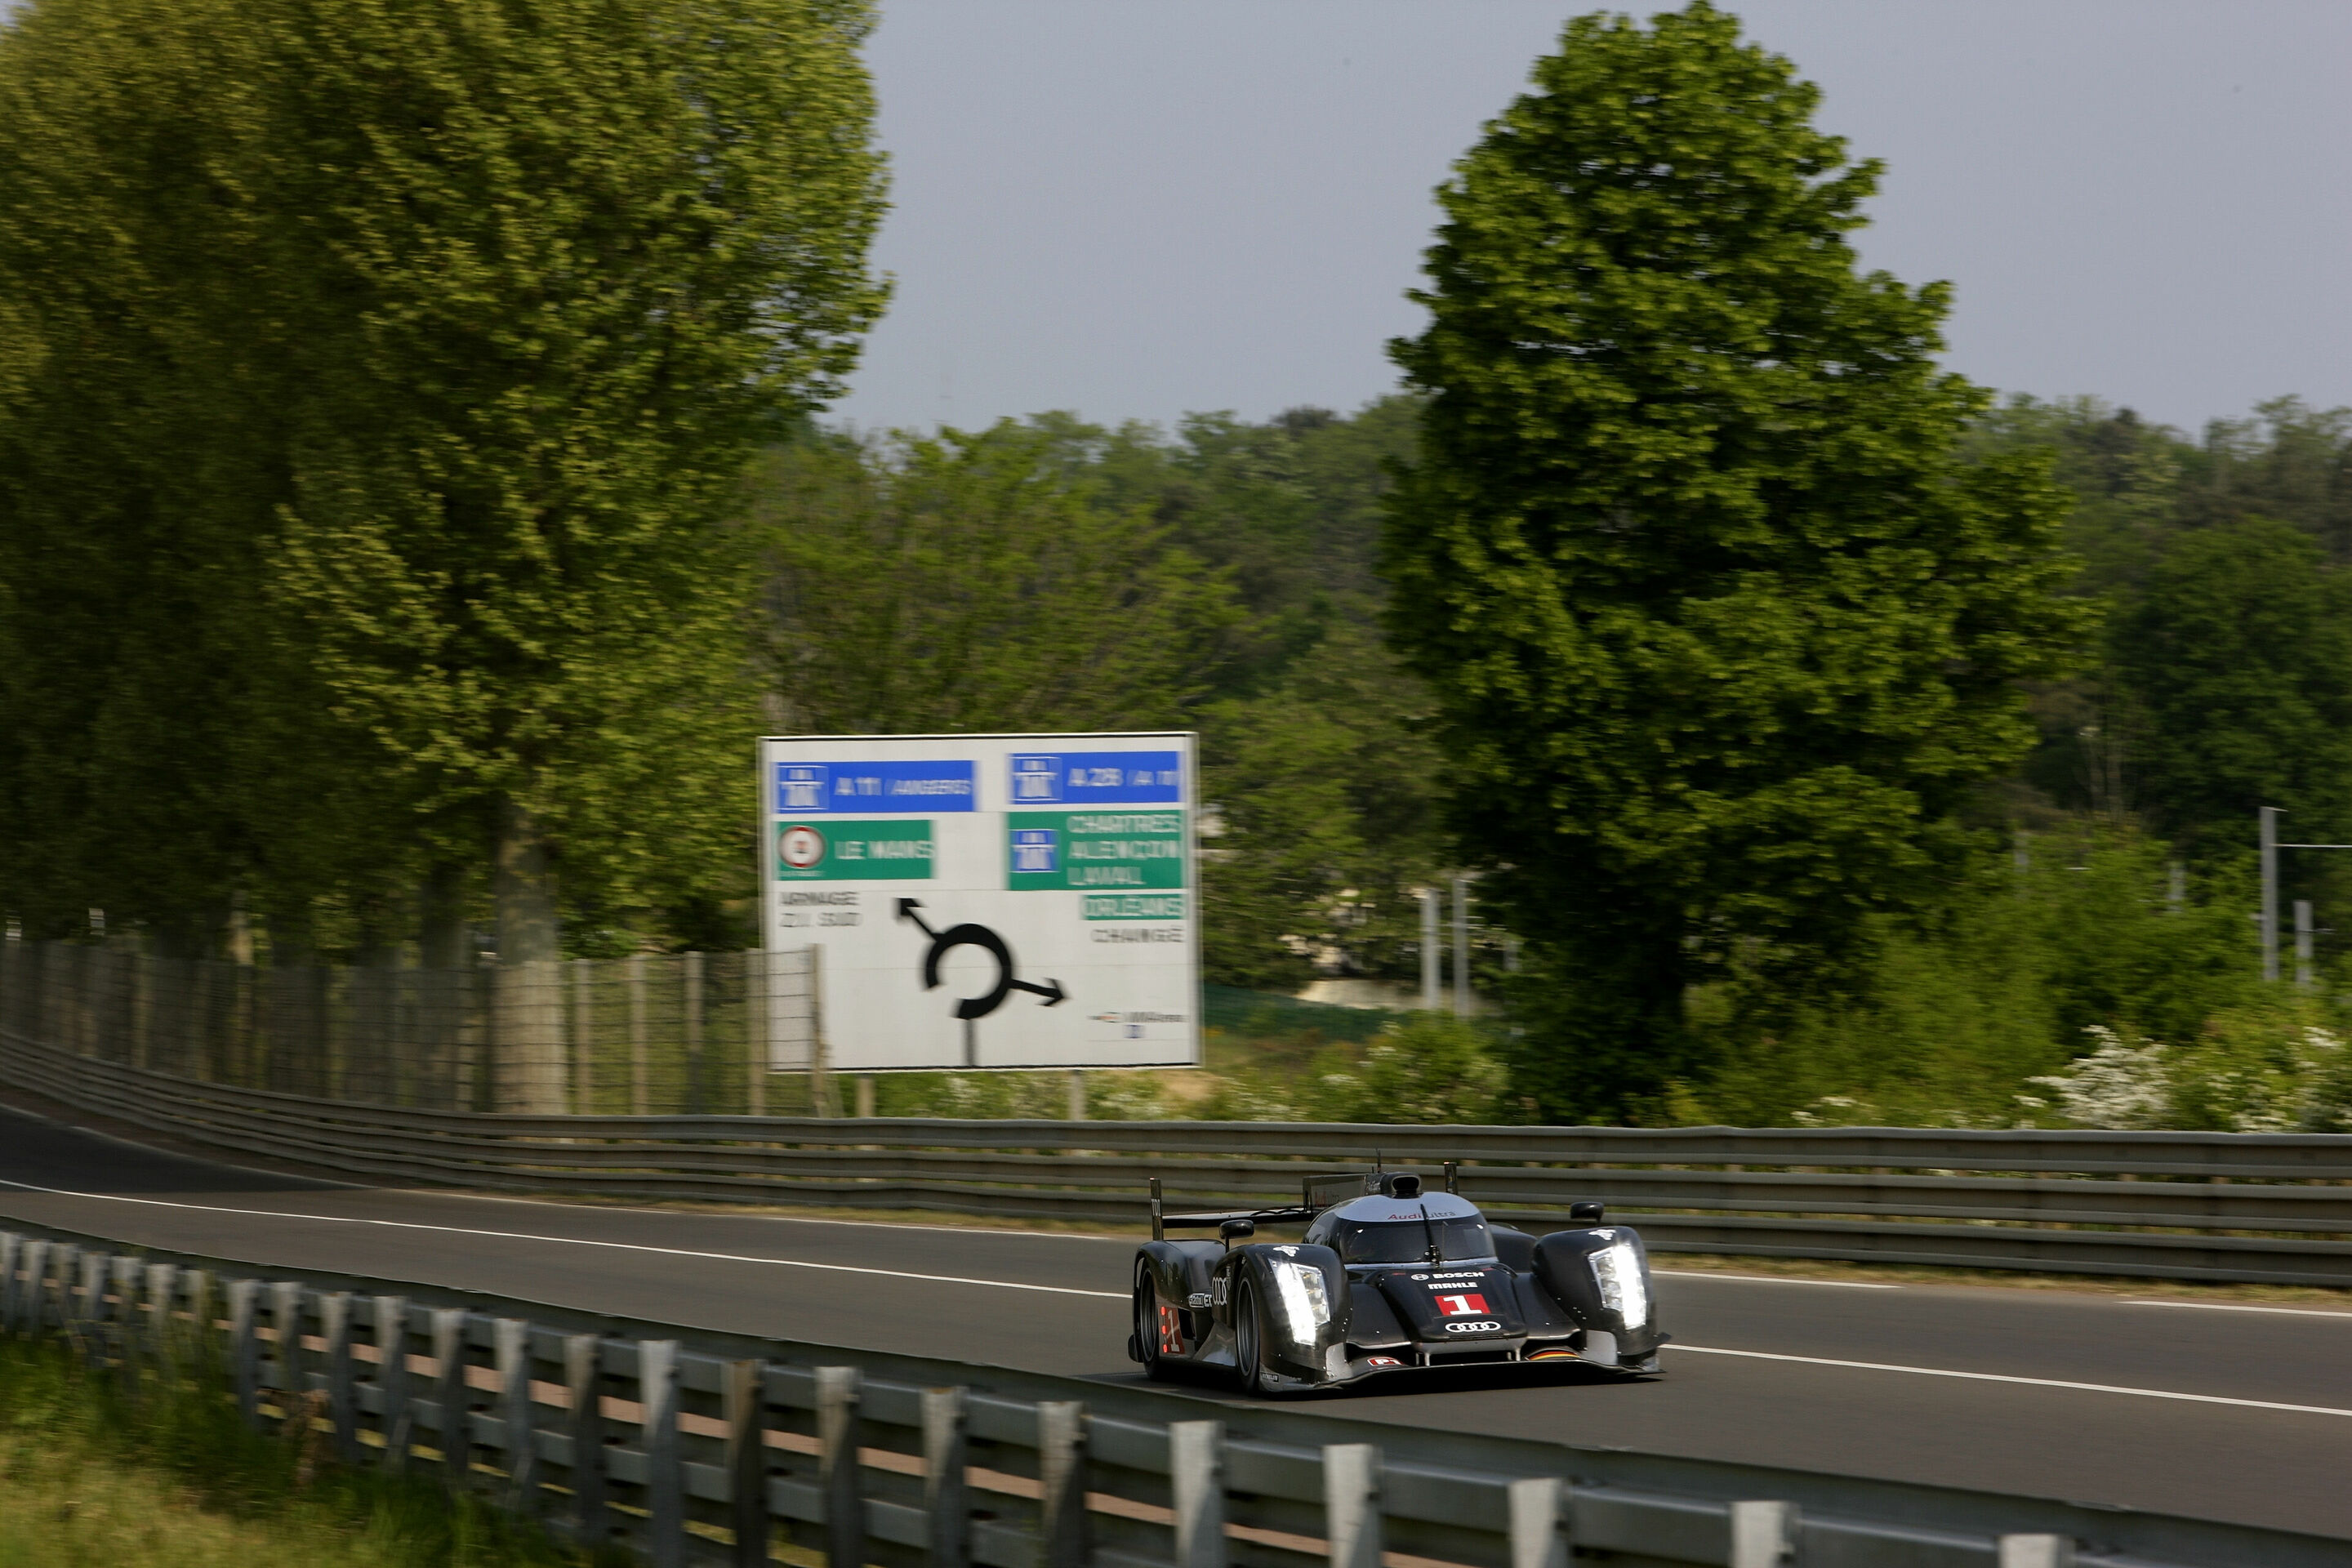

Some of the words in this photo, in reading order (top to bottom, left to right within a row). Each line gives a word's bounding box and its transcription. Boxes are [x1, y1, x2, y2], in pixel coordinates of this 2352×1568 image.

[1067, 815, 1181, 834] CHARTRES
[834, 841, 866, 860] LE
[867, 840, 936, 859] MANS
[1067, 866, 1147, 885] LAVAL
[779, 891, 861, 906] ARNAGE
[1151, 1198, 1161, 1216] TDI
[1388, 1212, 1423, 1220] Audi
[1443, 1295, 1482, 1316] 1
[1168, 1310, 1180, 1352] 1
